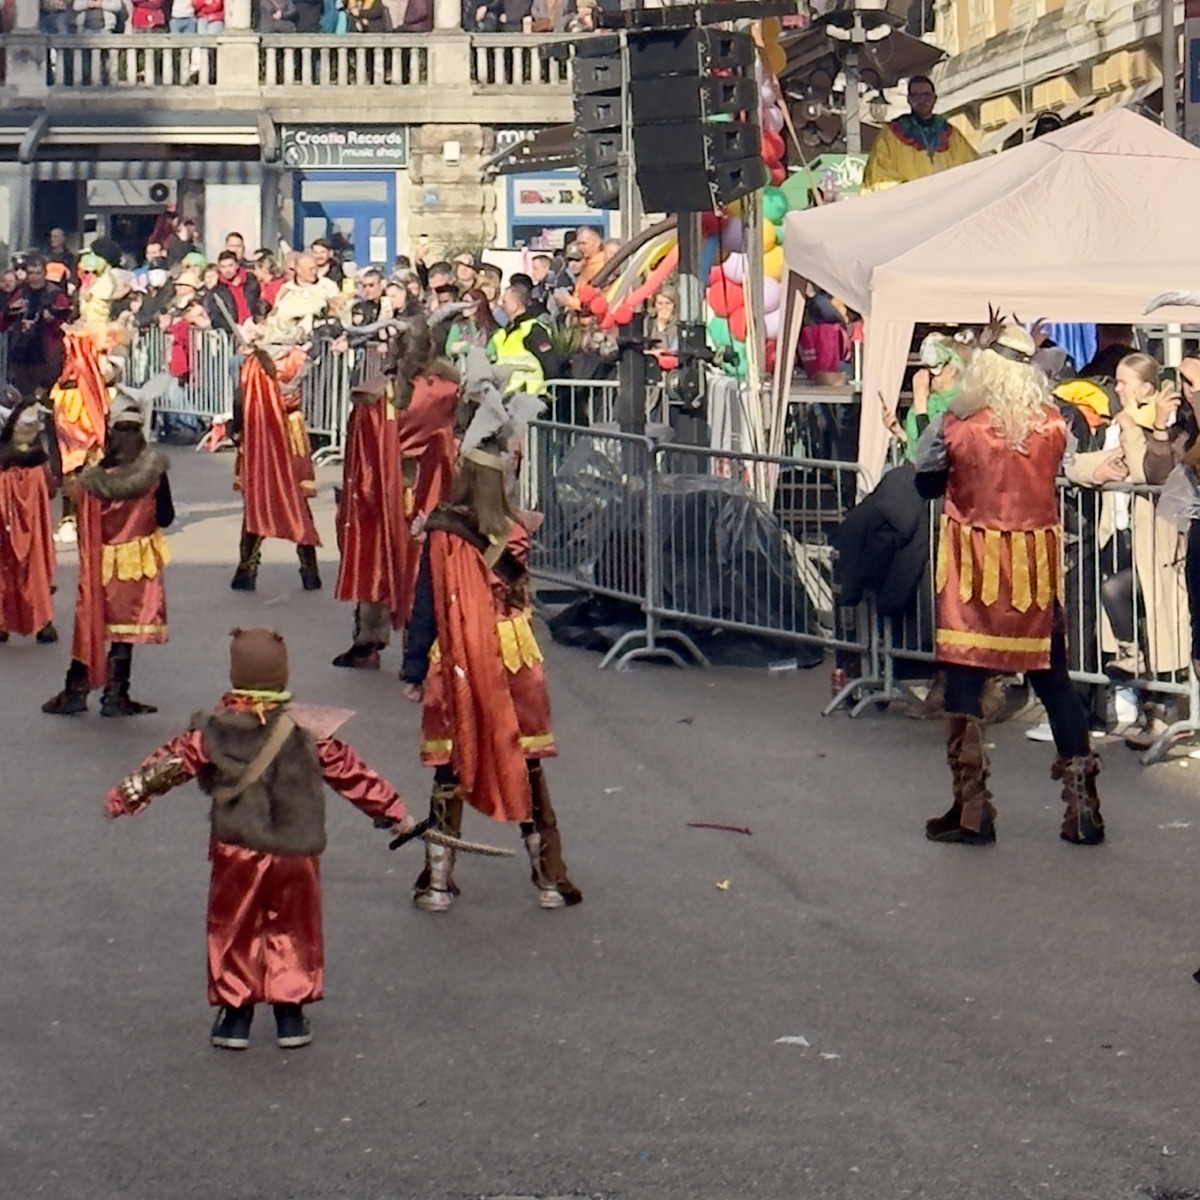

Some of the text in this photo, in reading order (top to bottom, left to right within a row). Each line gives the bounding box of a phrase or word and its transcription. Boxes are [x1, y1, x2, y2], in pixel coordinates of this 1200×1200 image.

[295, 130, 403, 145] Croatia Records
[341, 147, 403, 159] music shop
